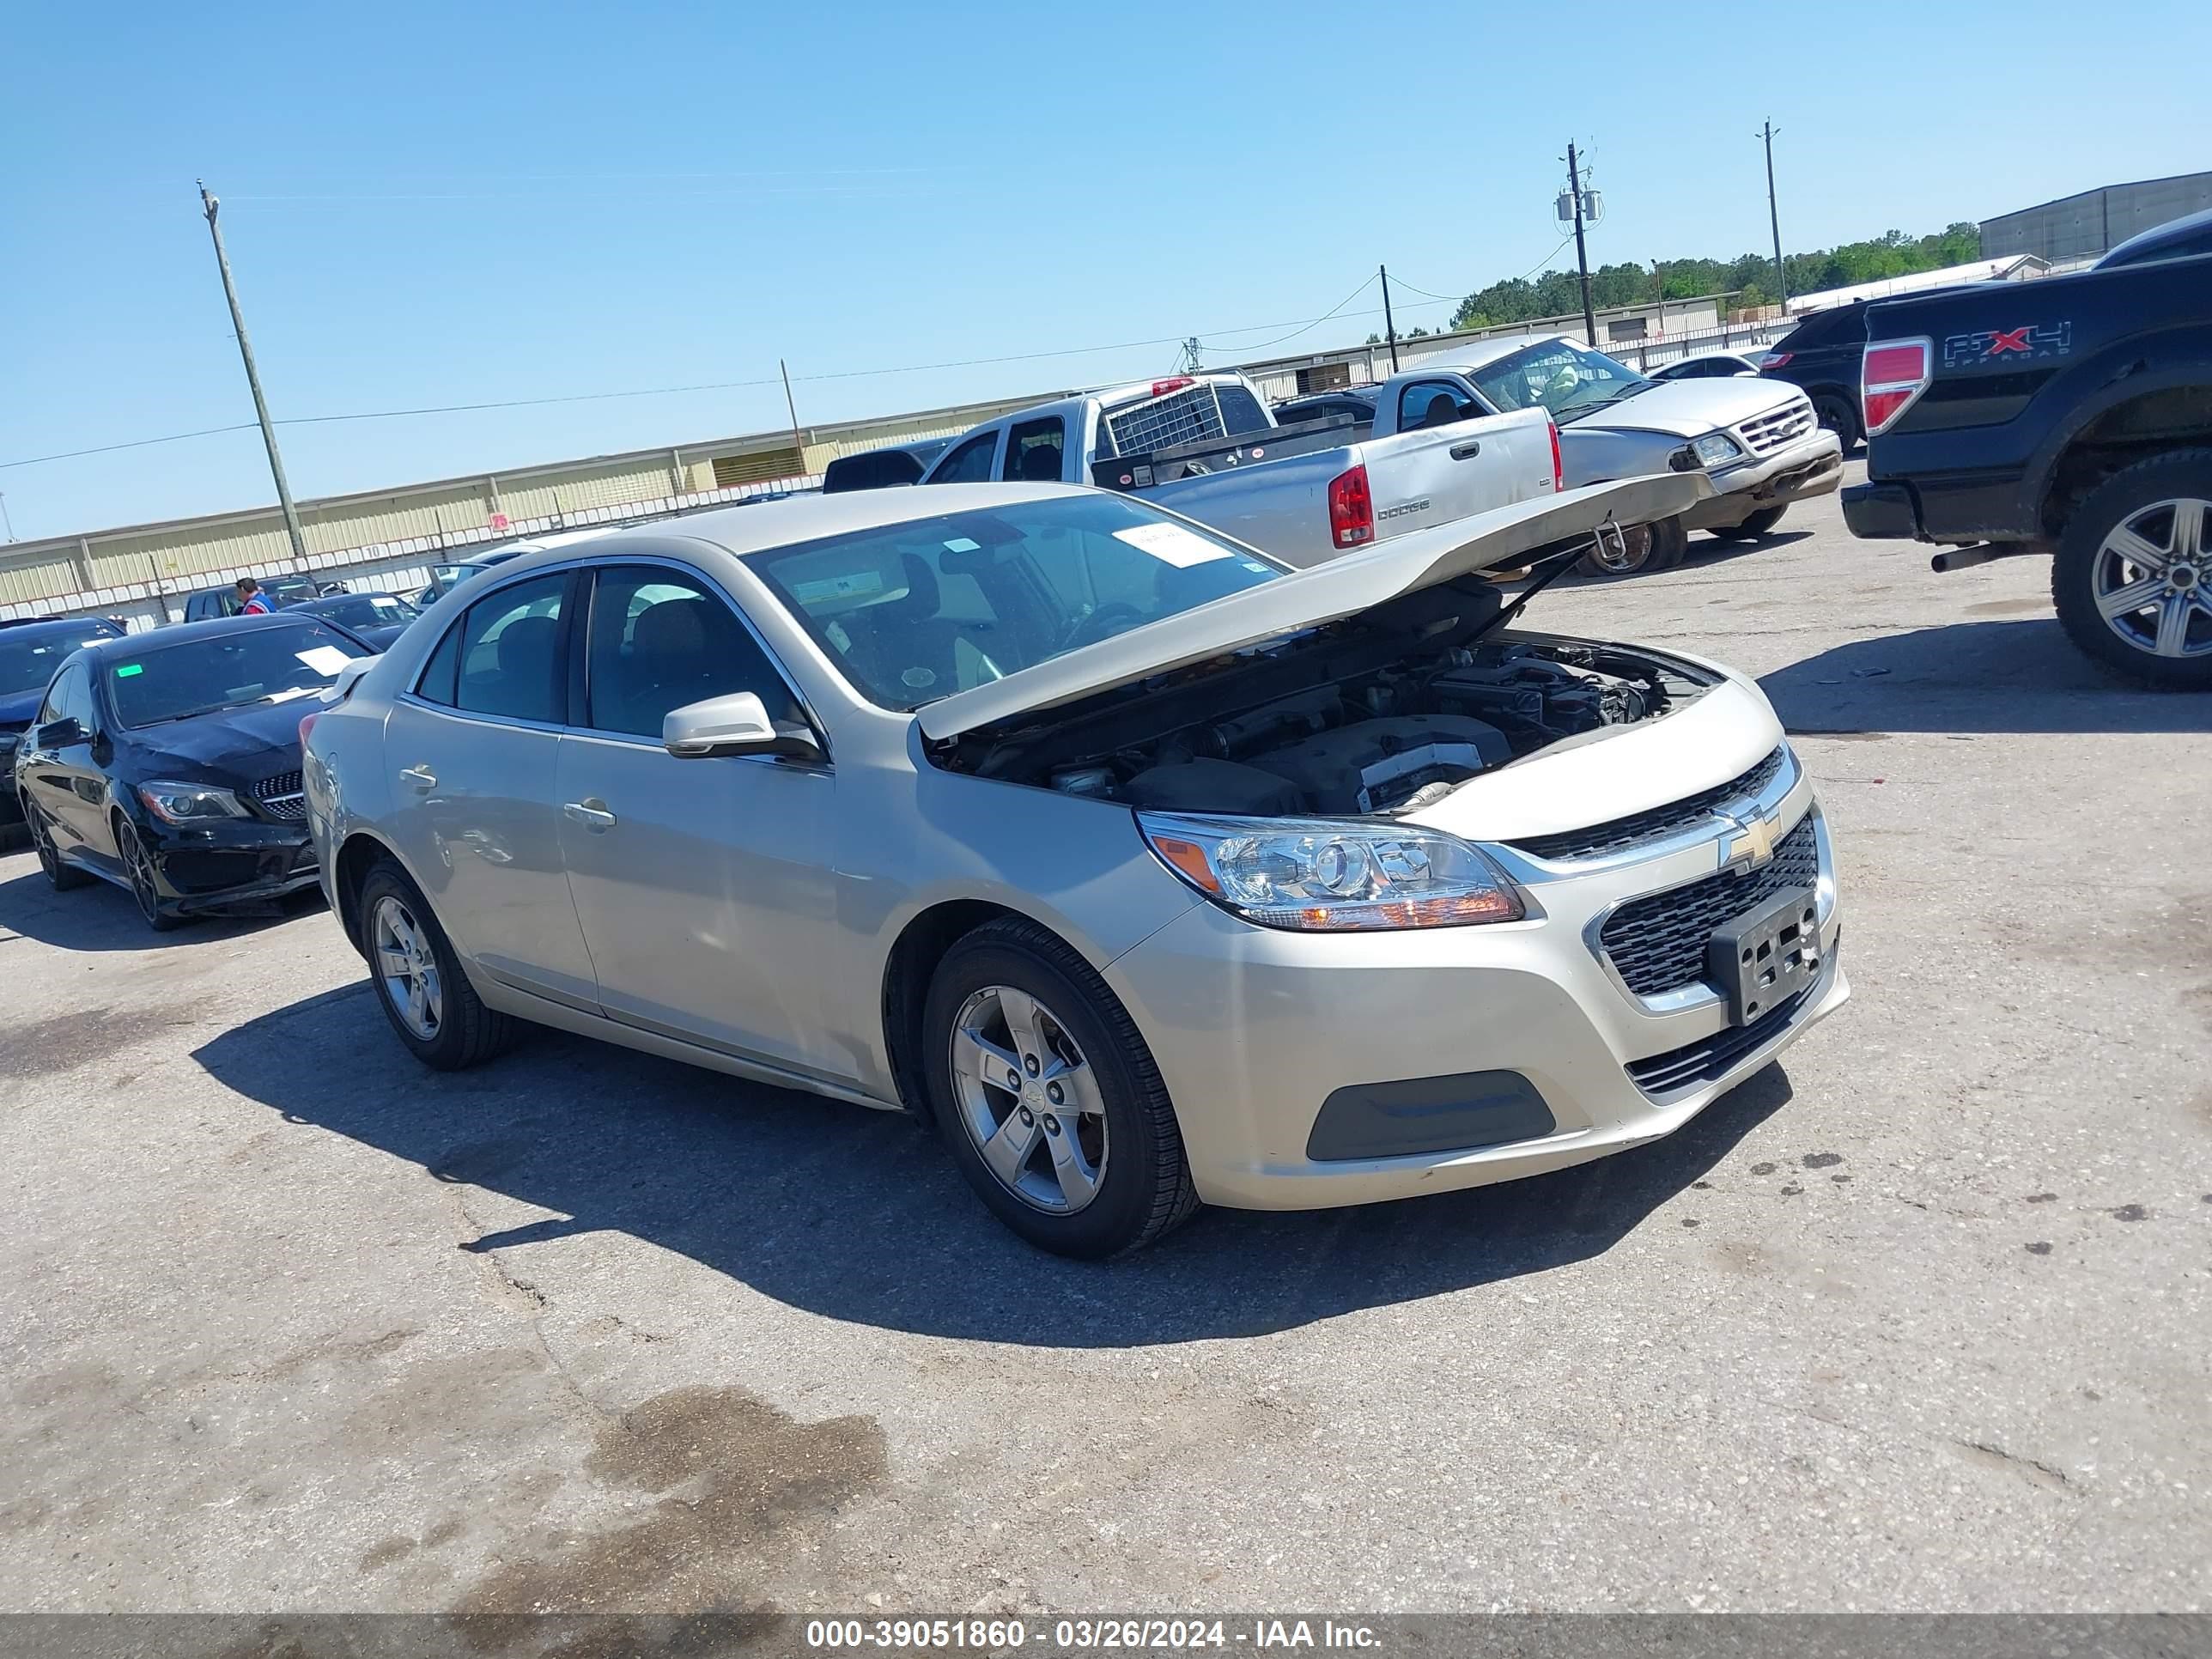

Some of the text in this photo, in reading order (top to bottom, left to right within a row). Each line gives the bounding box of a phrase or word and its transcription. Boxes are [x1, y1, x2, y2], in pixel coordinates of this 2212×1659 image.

[1944, 321, 2071, 360] FX4
[1945, 348, 2070, 368] OFF ROAD
[1377, 498, 1430, 520] DODGE
